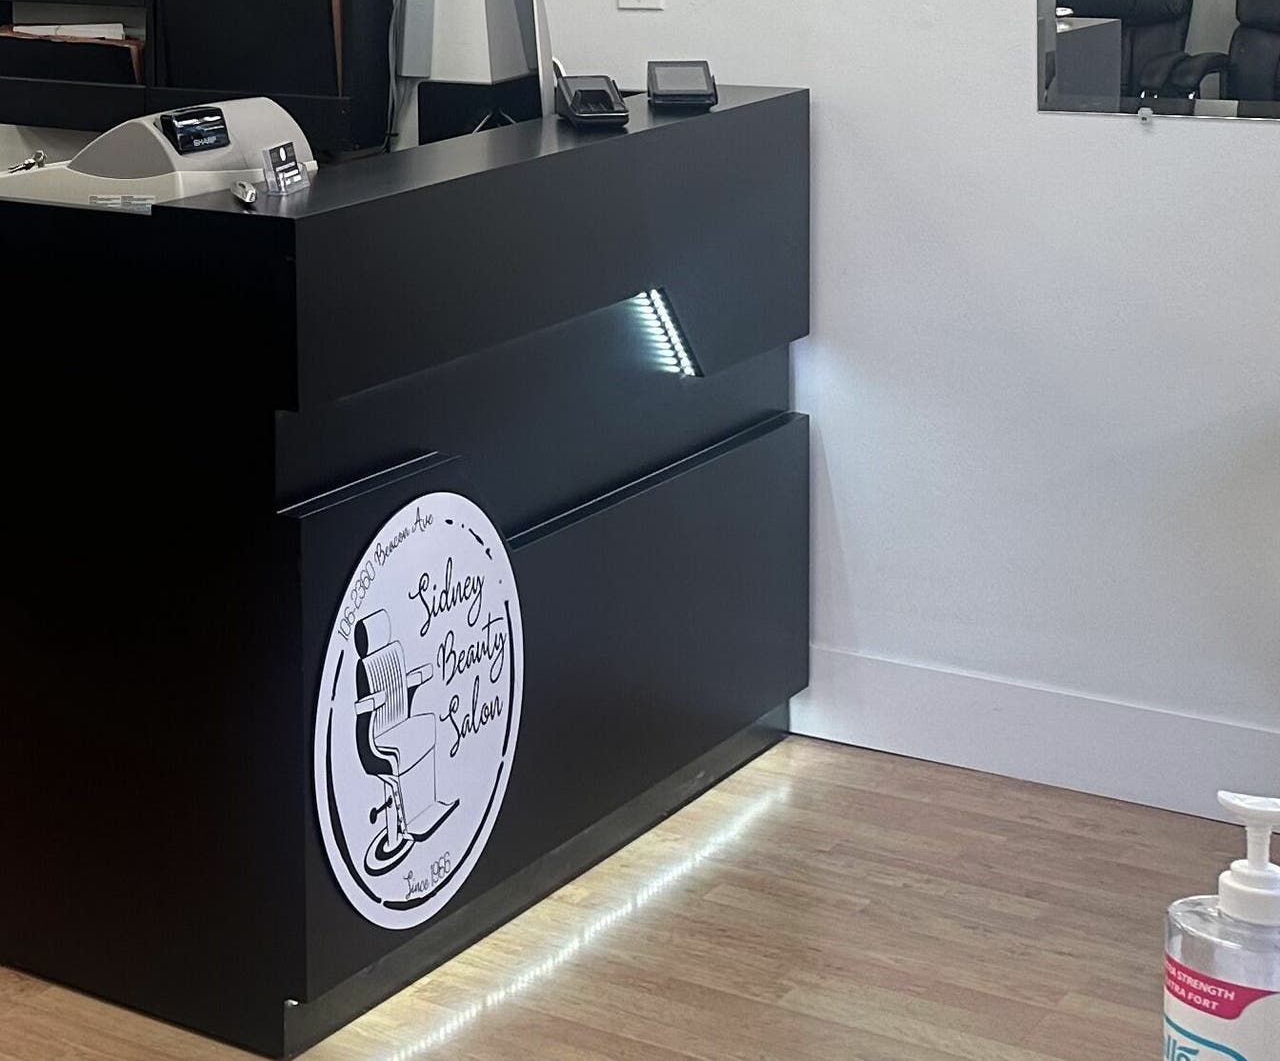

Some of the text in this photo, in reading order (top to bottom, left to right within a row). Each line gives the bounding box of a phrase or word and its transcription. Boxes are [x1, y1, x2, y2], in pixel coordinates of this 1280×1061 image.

[193, 136, 217, 147] SHARP
[337, 506, 434, 641] 106-2360 Beacon Ave
[408, 557, 485, 637] Sidney
[437, 612, 507, 686] Beauty
[439, 675, 503, 758] Salon
[403, 870, 429, 900] Since
[1177, 970, 1236, 1001] STRENGTH
[1187, 991, 1220, 1011] FORT
